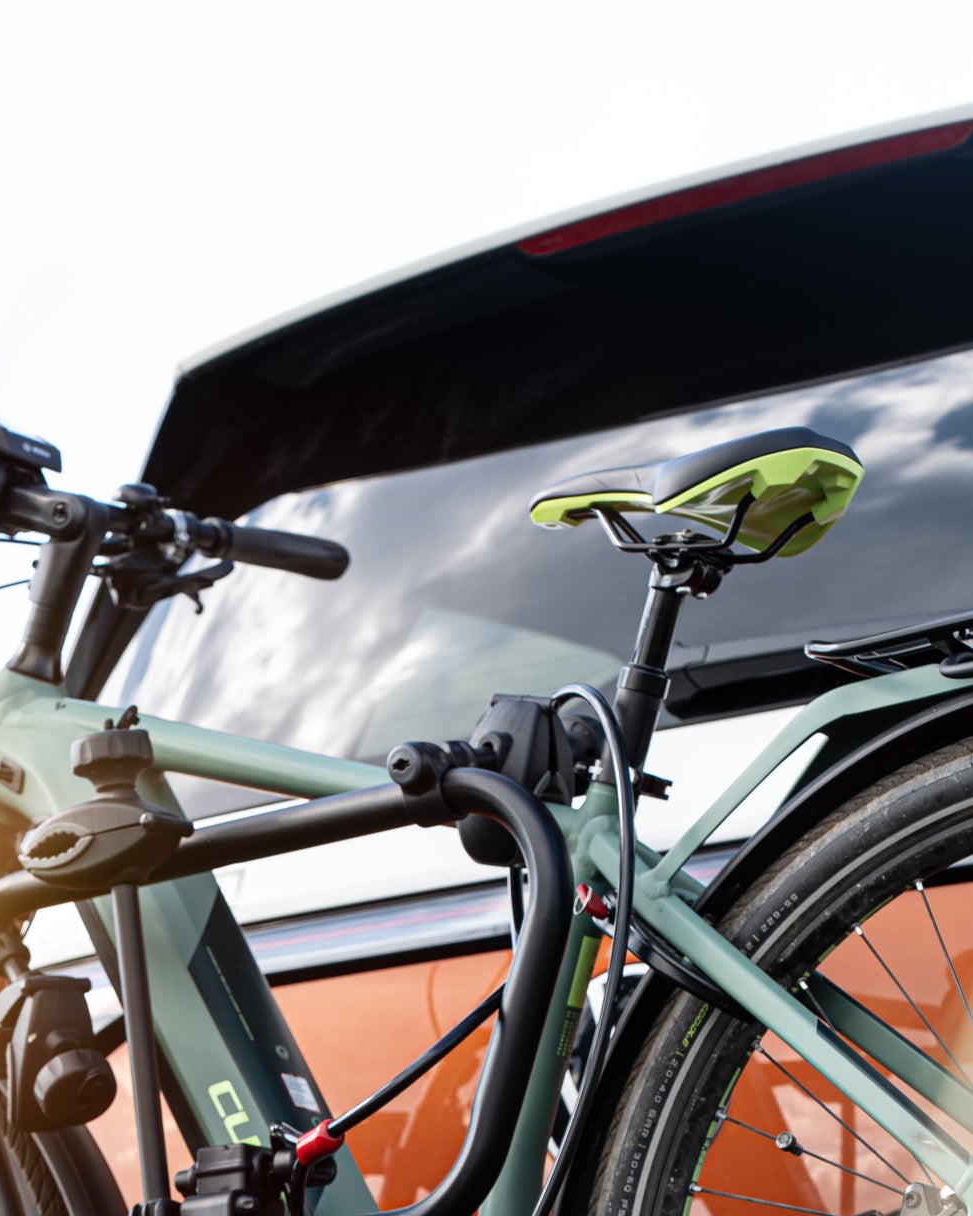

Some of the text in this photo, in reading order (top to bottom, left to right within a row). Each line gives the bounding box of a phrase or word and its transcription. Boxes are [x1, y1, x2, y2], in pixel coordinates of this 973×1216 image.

[760, 893, 799, 933] 55-622
[208, 1080, 261, 1146] CU
[640, 1108, 658, 1139] BAR
